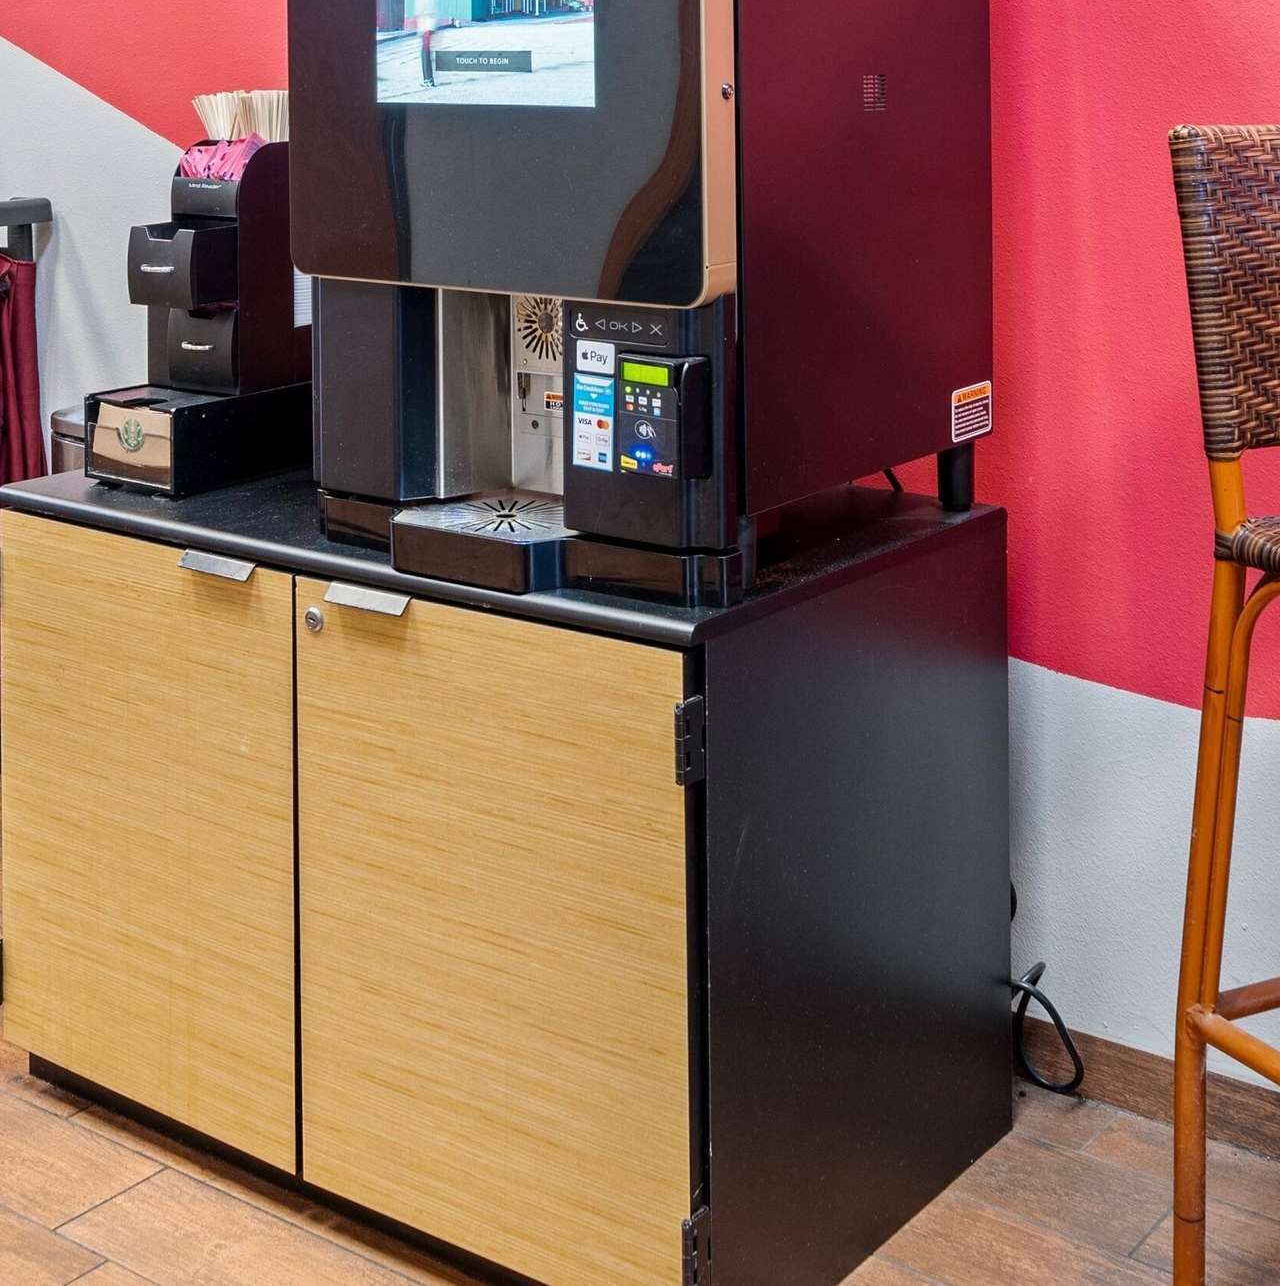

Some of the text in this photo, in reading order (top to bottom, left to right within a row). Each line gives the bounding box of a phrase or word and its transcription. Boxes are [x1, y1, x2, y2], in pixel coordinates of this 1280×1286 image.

[456, 57, 509, 65] TOUCH TO BEGIN
[609, 321, 628, 331] OK
[590, 351, 608, 366] Pay
[578, 417, 592, 426] VISA
